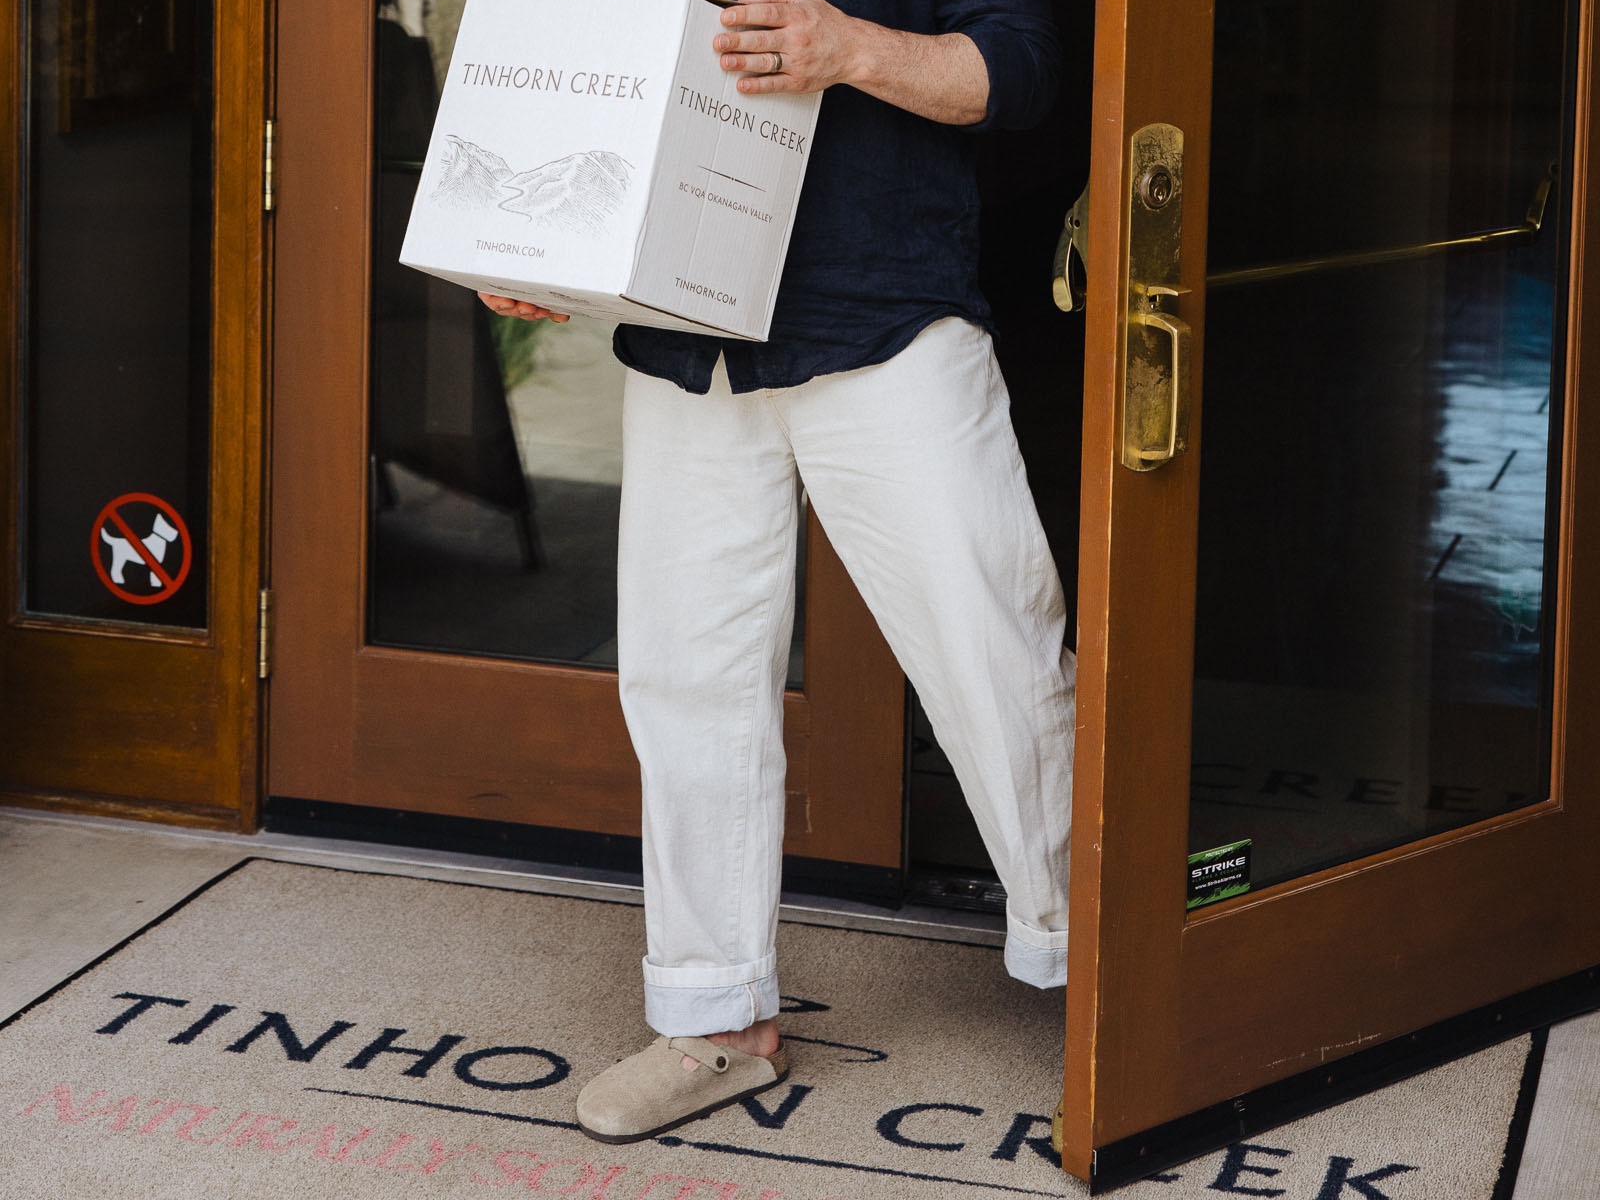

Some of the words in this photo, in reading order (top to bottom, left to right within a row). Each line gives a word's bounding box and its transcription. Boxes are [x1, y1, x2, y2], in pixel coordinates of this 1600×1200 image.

[463, 63, 563, 92] TINHORN
[570, 71, 647, 100] CREEK
[680, 86, 755, 133] TINHORN
[759, 120, 806, 154] CREEK
[679, 181, 689, 192] BC
[690, 186, 706, 200] VQA
[707, 192, 749, 215] OKANAGAN
[750, 208, 773, 224] VALLEY
[476, 239, 545, 259] TINHORN.COM
[675, 277, 737, 307] TINHORN.COM
[1191, 856, 1246, 878] STRIKE
[95, 992, 814, 1129] TINHON
[875, 1103, 1418, 1200] CREK
[16, 1084, 481, 1174] NATURALLY
